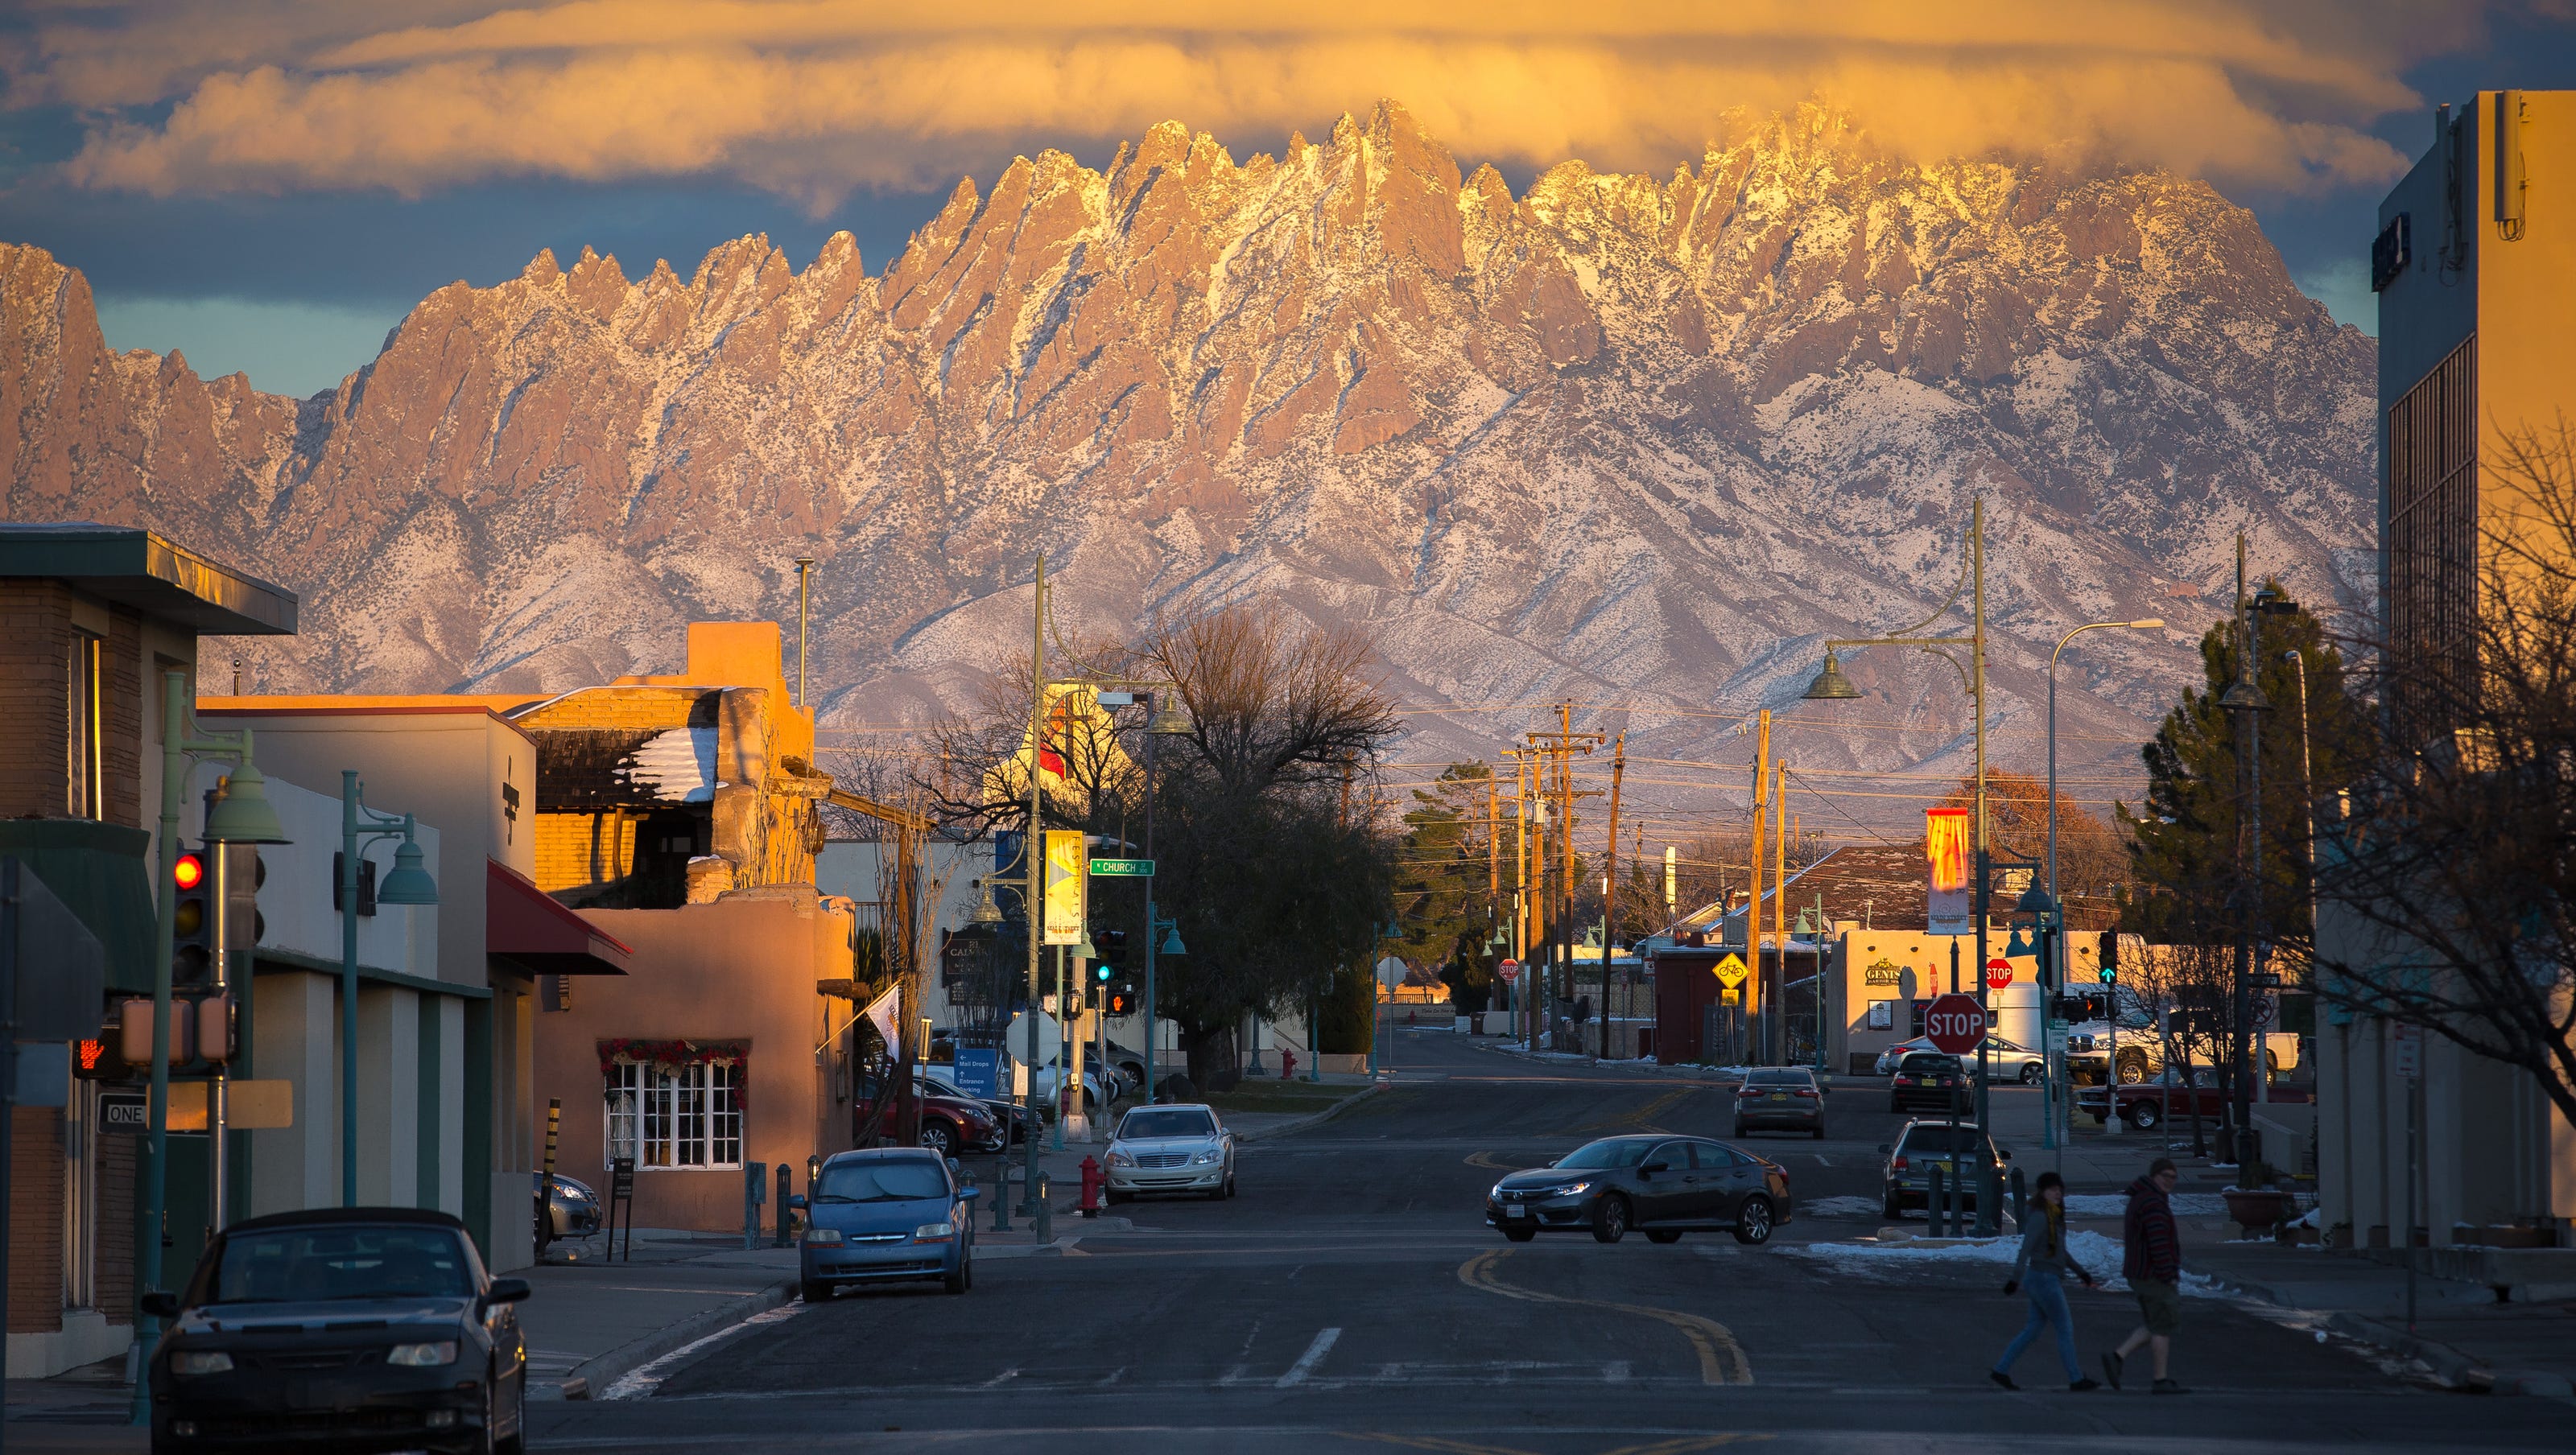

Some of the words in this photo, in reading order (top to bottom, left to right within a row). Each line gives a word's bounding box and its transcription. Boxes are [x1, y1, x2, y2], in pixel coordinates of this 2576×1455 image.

[1103, 863, 1136, 872] CHURCH
[1867, 970, 1901, 979] GENTS
[1986, 968, 2012, 979] STOP
[1930, 1013, 1983, 1037] STOP
[110, 1107, 142, 1122] ONE
